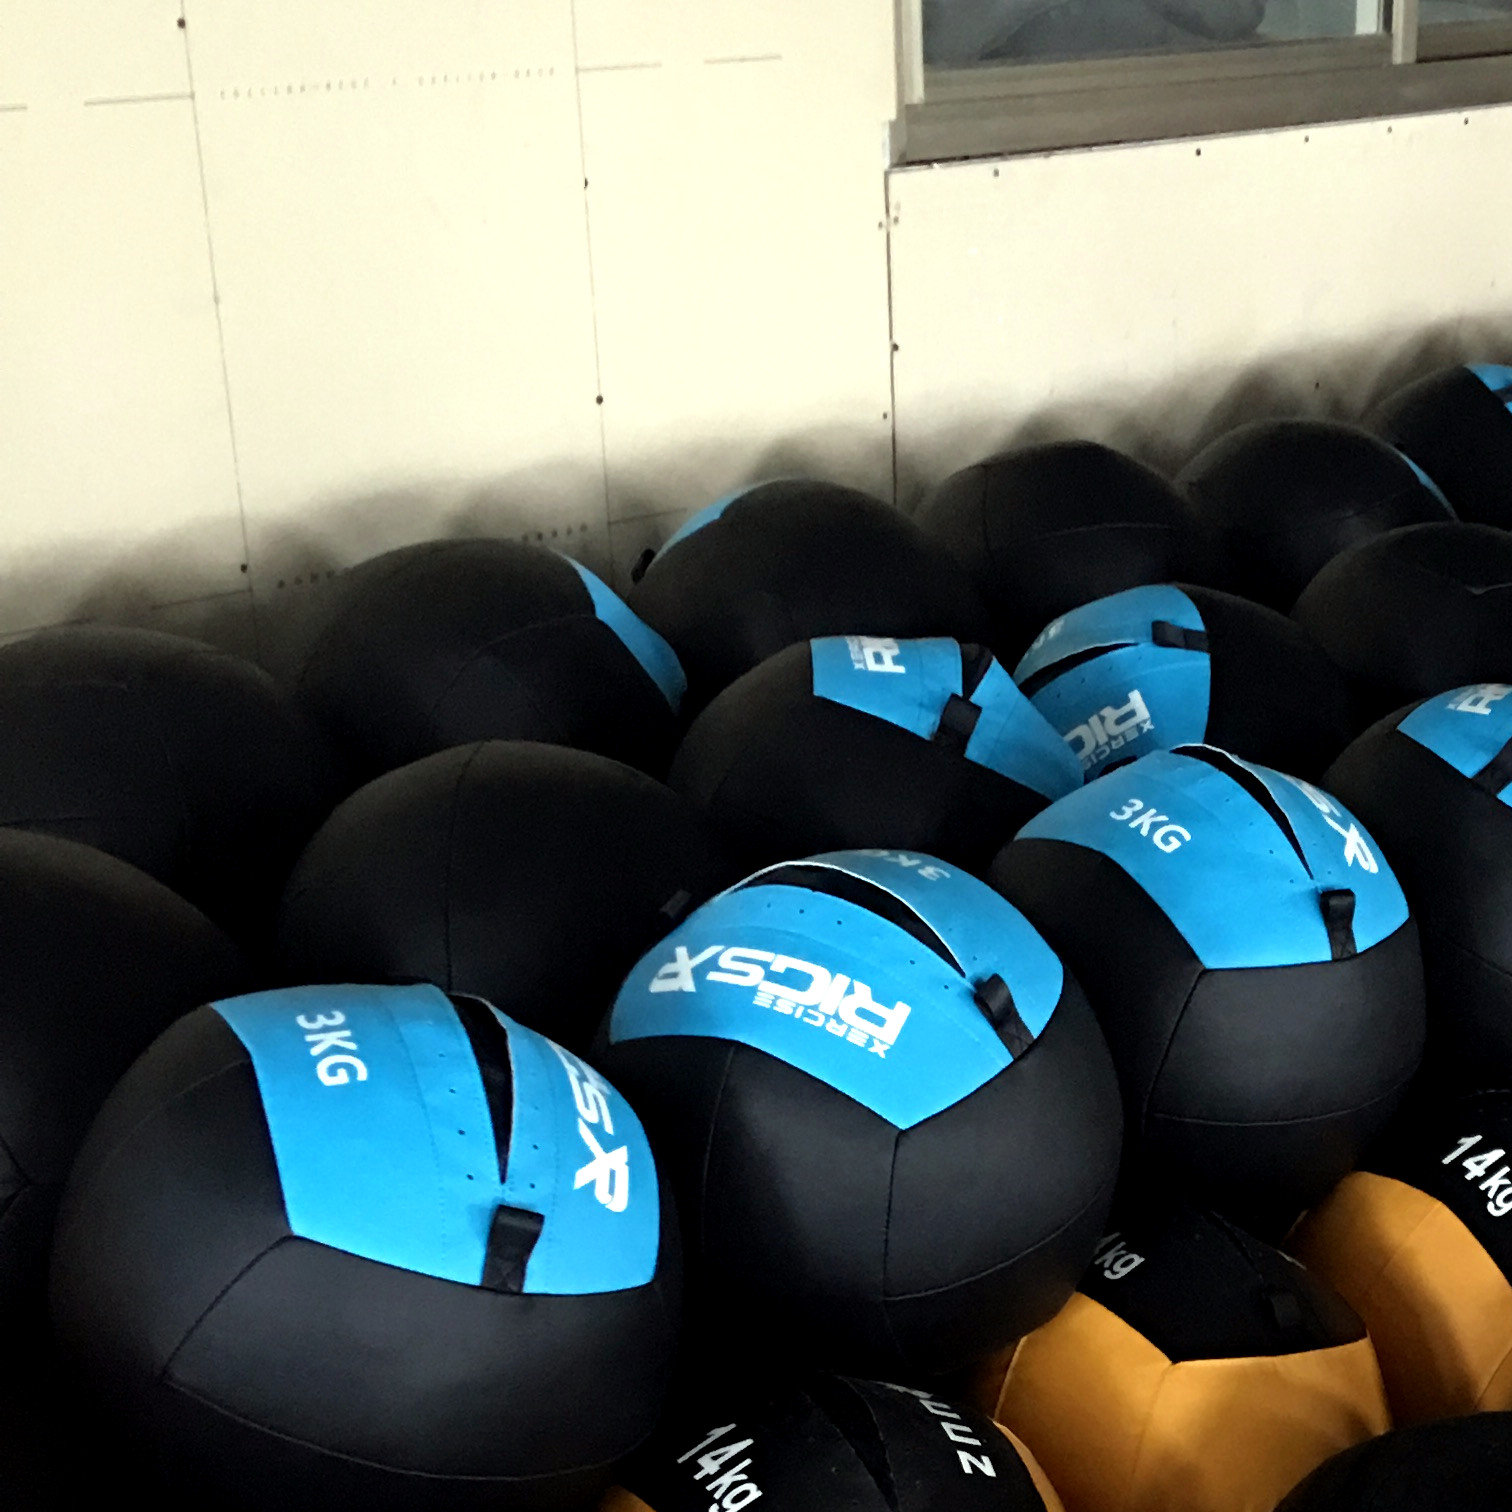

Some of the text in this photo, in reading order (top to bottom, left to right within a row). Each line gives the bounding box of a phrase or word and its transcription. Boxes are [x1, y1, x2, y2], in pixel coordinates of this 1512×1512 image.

[1109, 798, 1192, 854] 3KG
[296, 1010, 368, 1087] 3KG
[751, 988, 892, 1060] XERCISE
